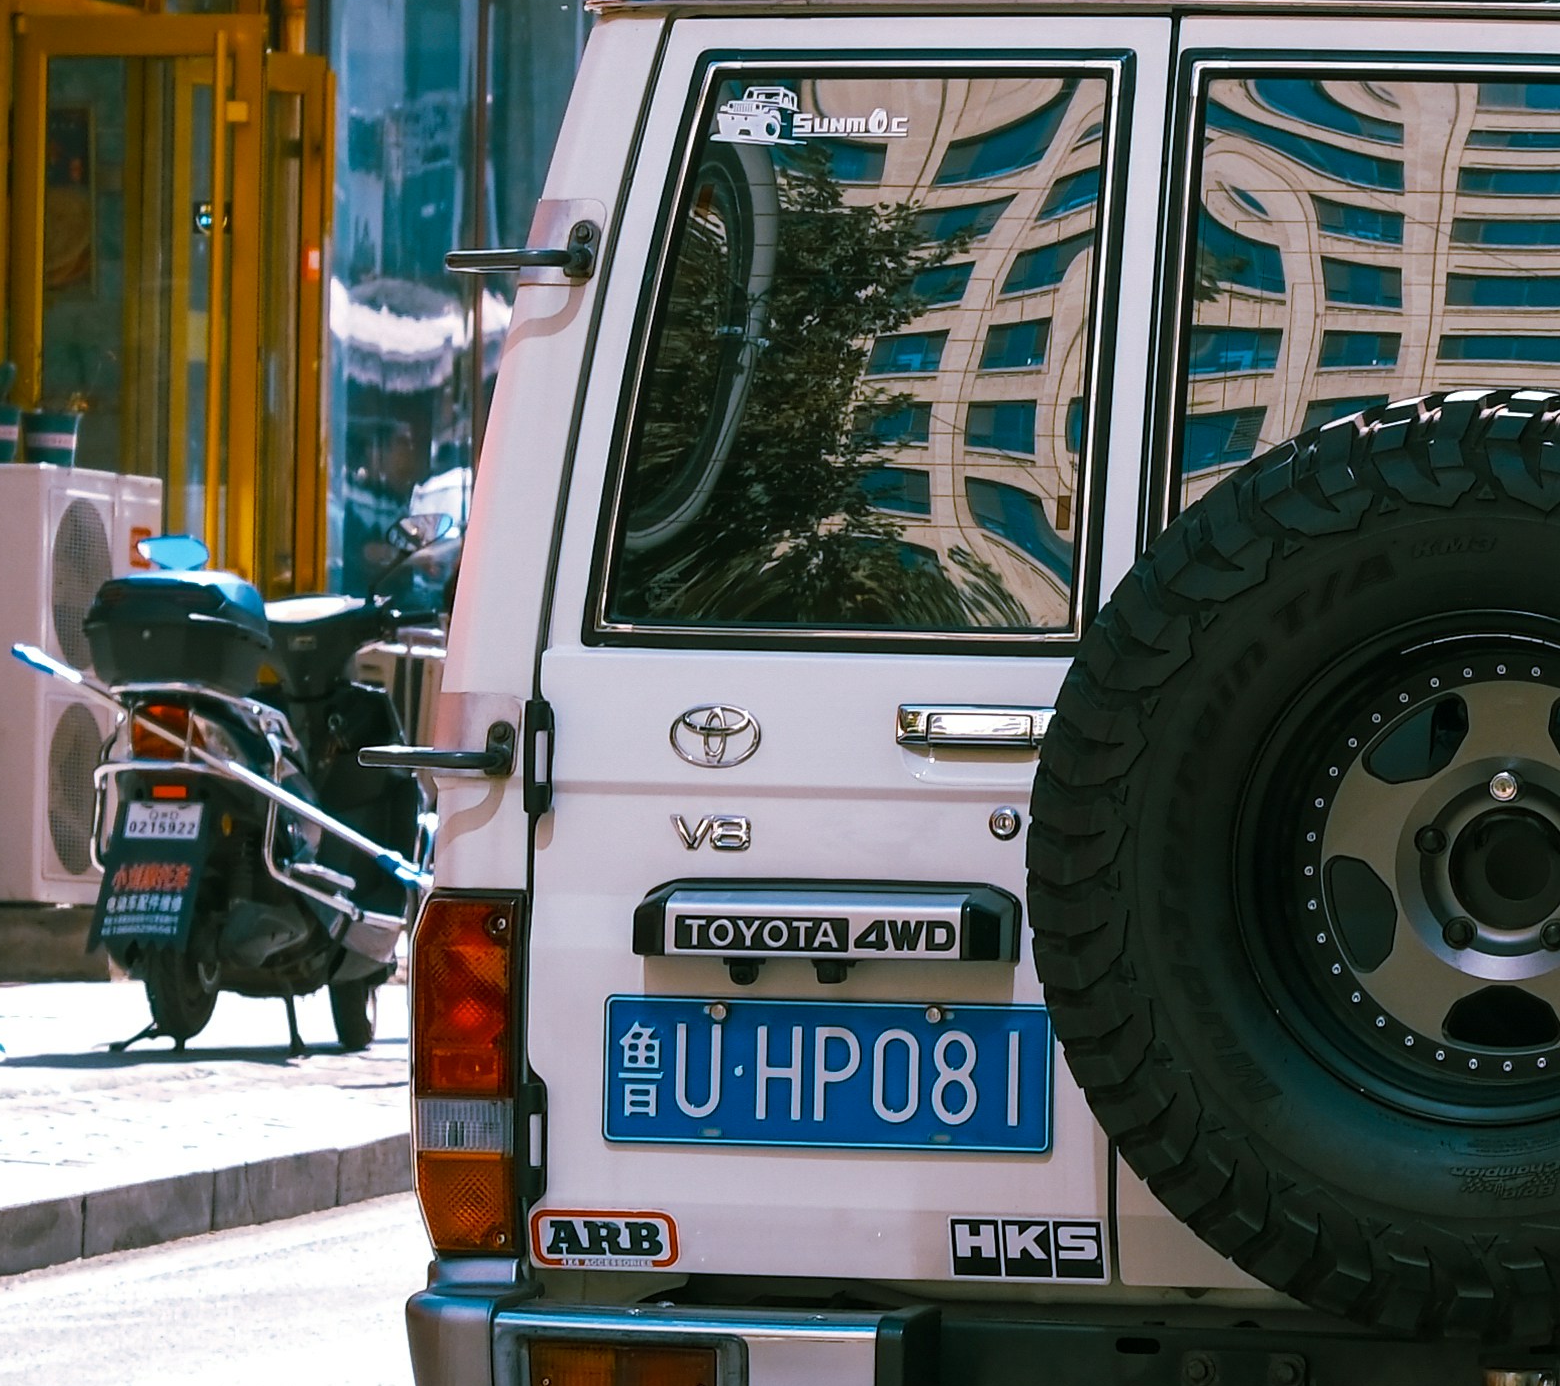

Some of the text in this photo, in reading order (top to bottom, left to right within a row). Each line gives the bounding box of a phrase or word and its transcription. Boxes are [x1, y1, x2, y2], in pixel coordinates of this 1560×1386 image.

[128, 820, 196, 835] 0215922
[670, 814, 752, 852] V8
[684, 917, 957, 953] TOYOTA 4WD
[546, 1219, 664, 1256] ARB
[953, 1221, 1103, 1269] HKS
